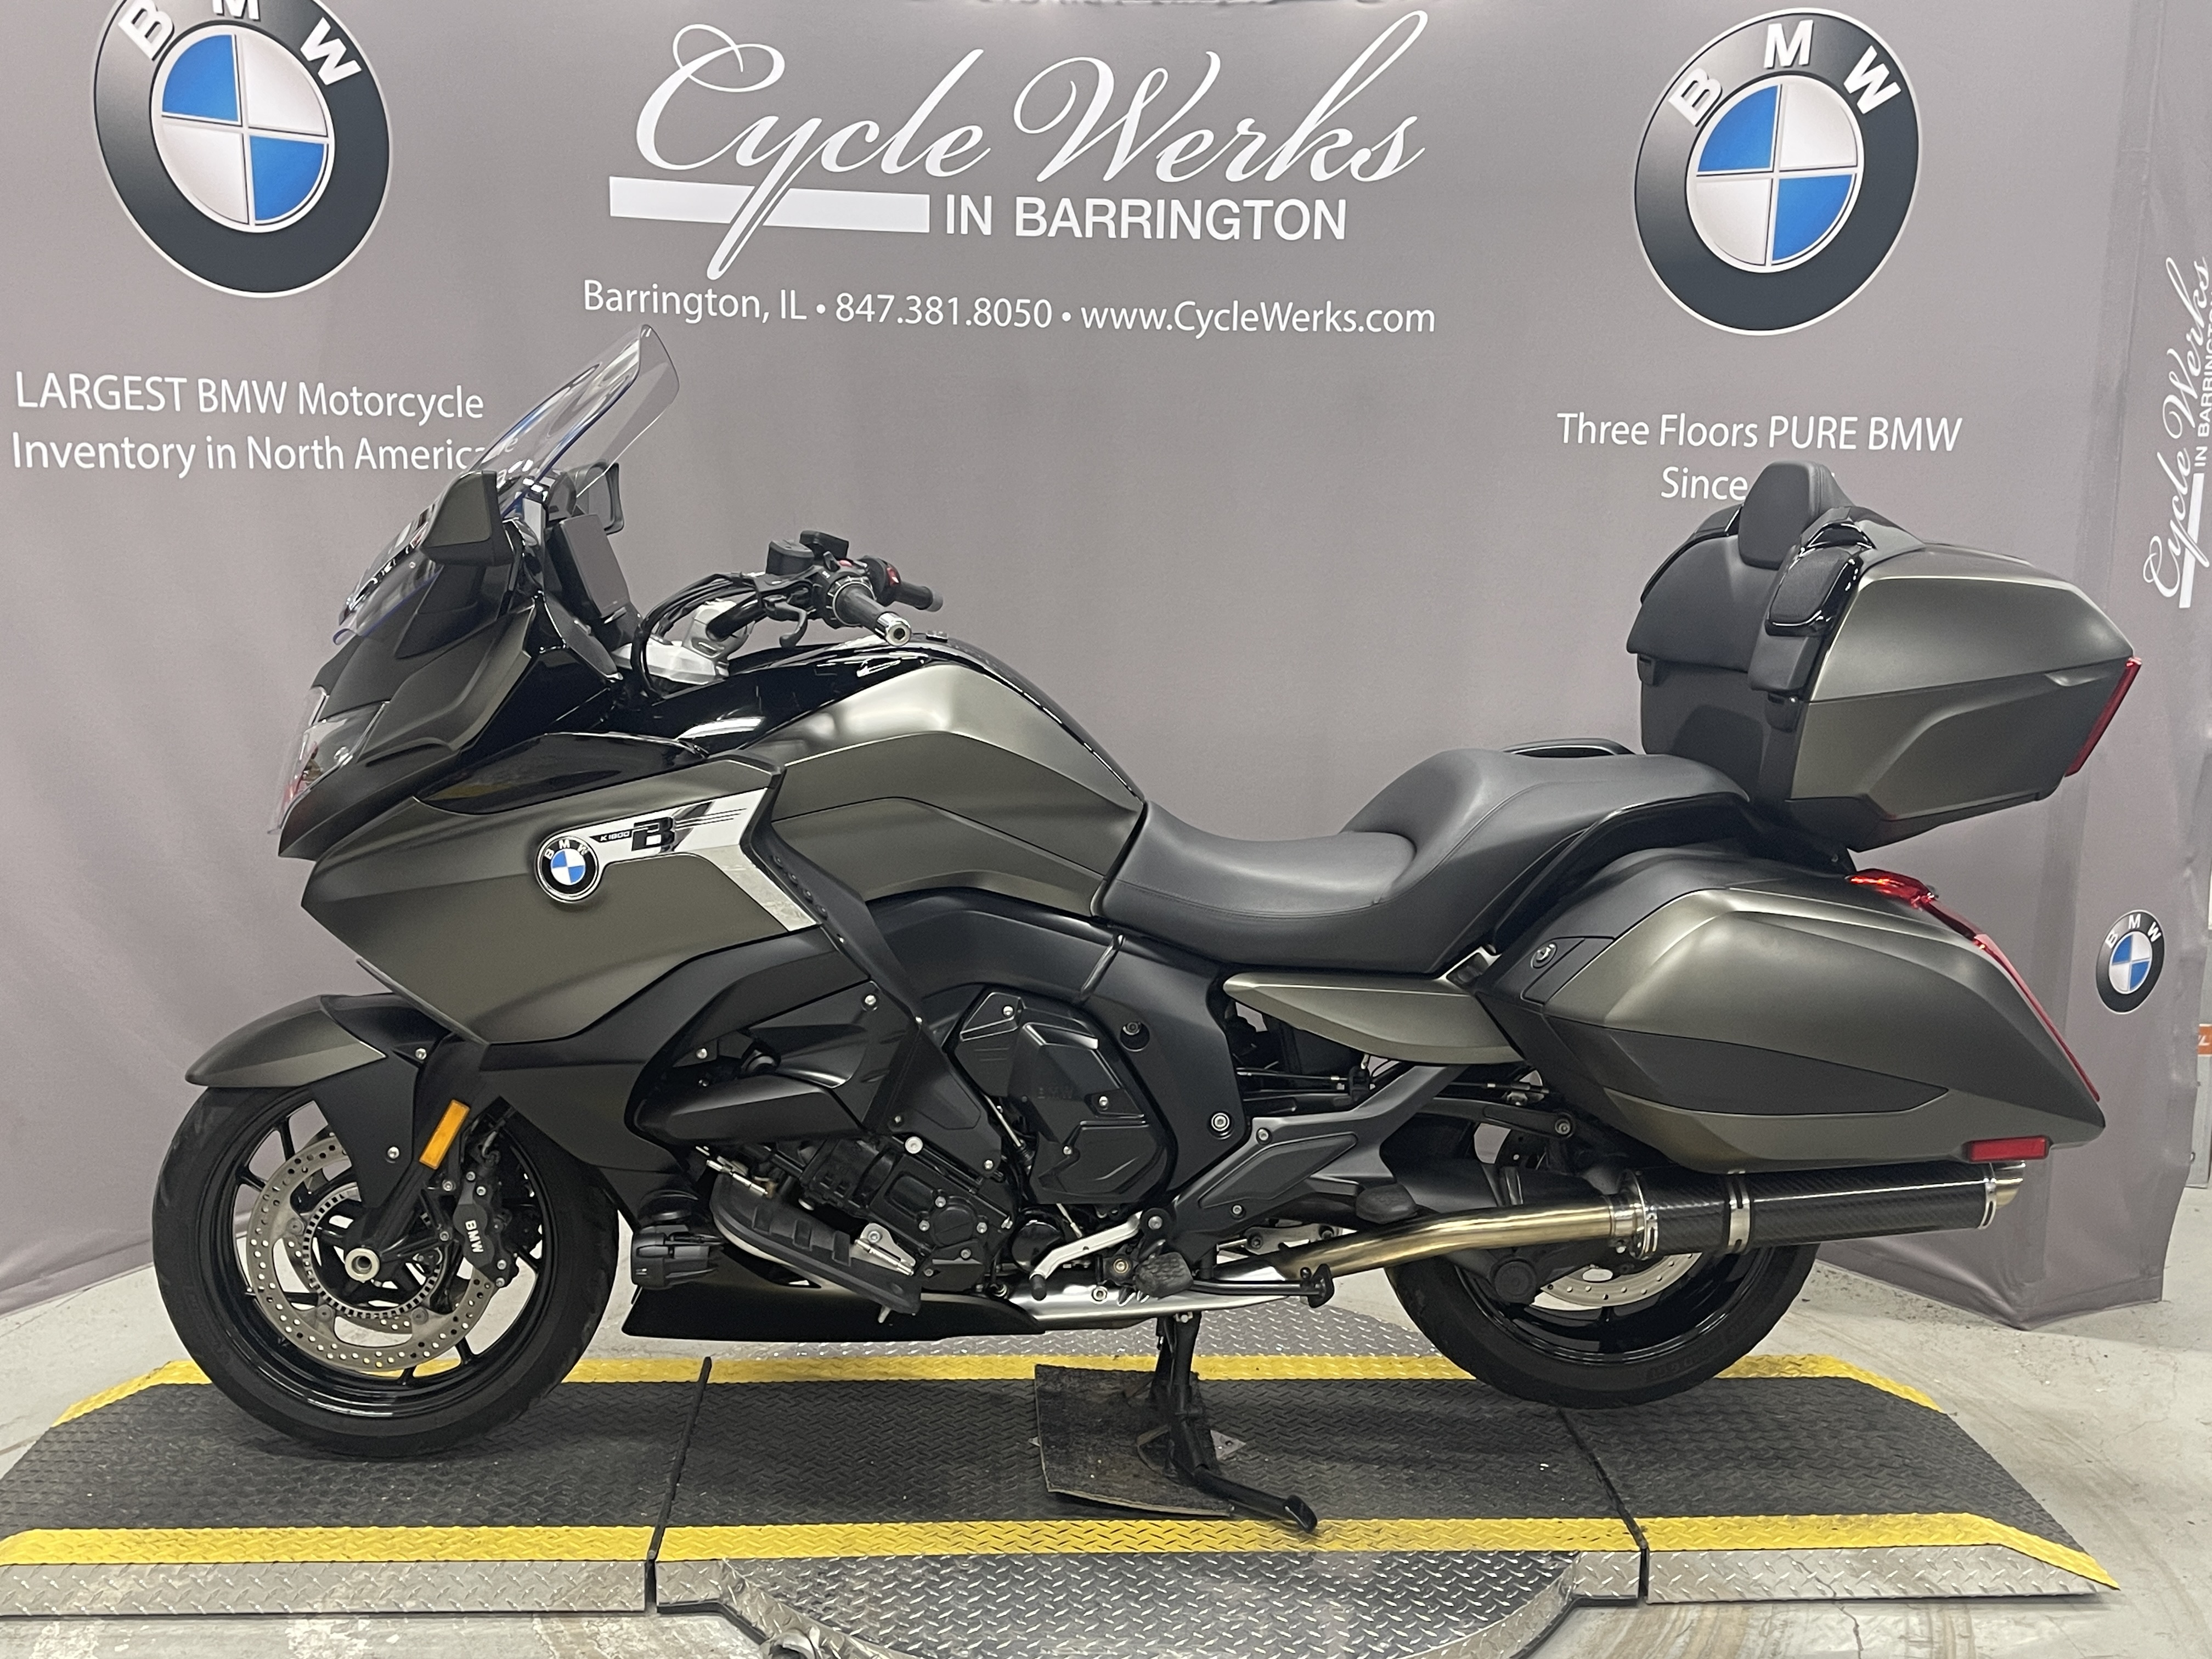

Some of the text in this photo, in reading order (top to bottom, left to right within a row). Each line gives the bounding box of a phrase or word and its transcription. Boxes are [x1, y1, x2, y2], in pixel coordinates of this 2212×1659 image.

[1668, 20, 1901, 127] BMW
[636, 10, 1429, 280] Cycle Werks
[947, 194, 1346, 240] IN BARRINGTON
[584, 280, 1435, 339] Barrington, IL 847.381.8050 www.CycleWerks.com
[16, 371, 484, 426] LARGEST BMW Motorcycle
[2194, 292, 2212, 467] IN BARRIN
[1557, 411, 1963, 452] Three Floors PURE BMW
[2143, 257, 2210, 597] Cycle Werks
[13, 432, 486, 479] Inventory in North Americ
[1661, 466, 1748, 501] Since
[544, 839, 589, 860] BMW
[2105, 913, 2162, 949] BMW
[465, 1220, 484, 1253] BMW
